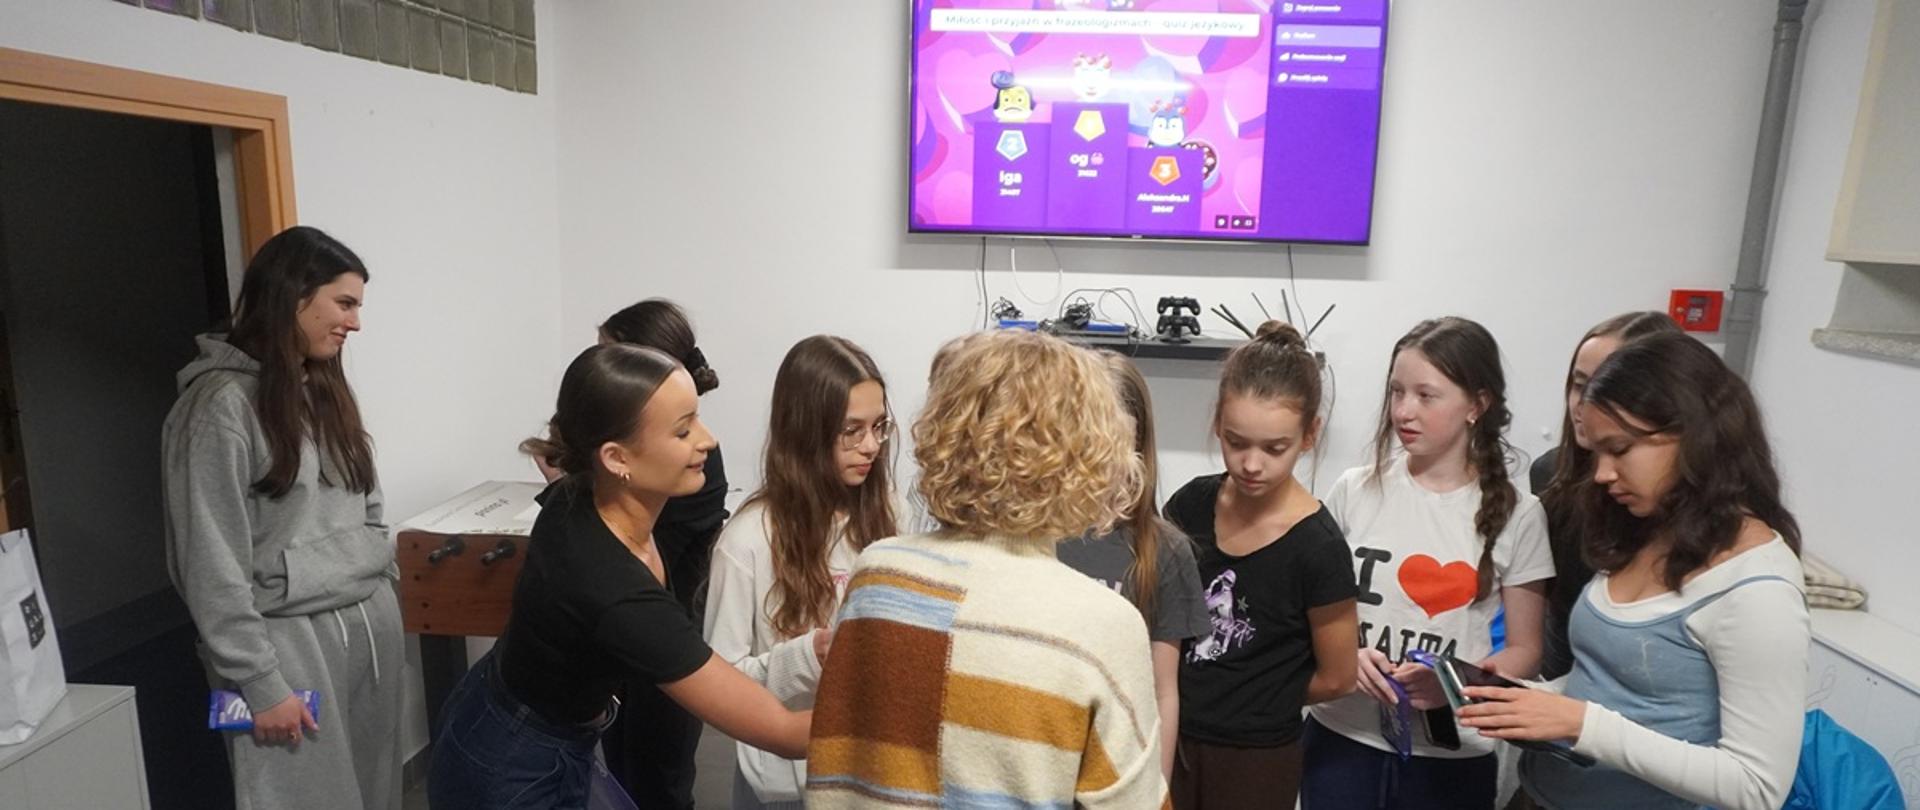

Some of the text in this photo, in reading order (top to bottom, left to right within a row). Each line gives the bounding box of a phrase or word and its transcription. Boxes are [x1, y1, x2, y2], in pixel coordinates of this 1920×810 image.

[1069, 153, 1089, 168] og
[1159, 163, 1172, 178] 3
[1355, 546, 1392, 606] I
